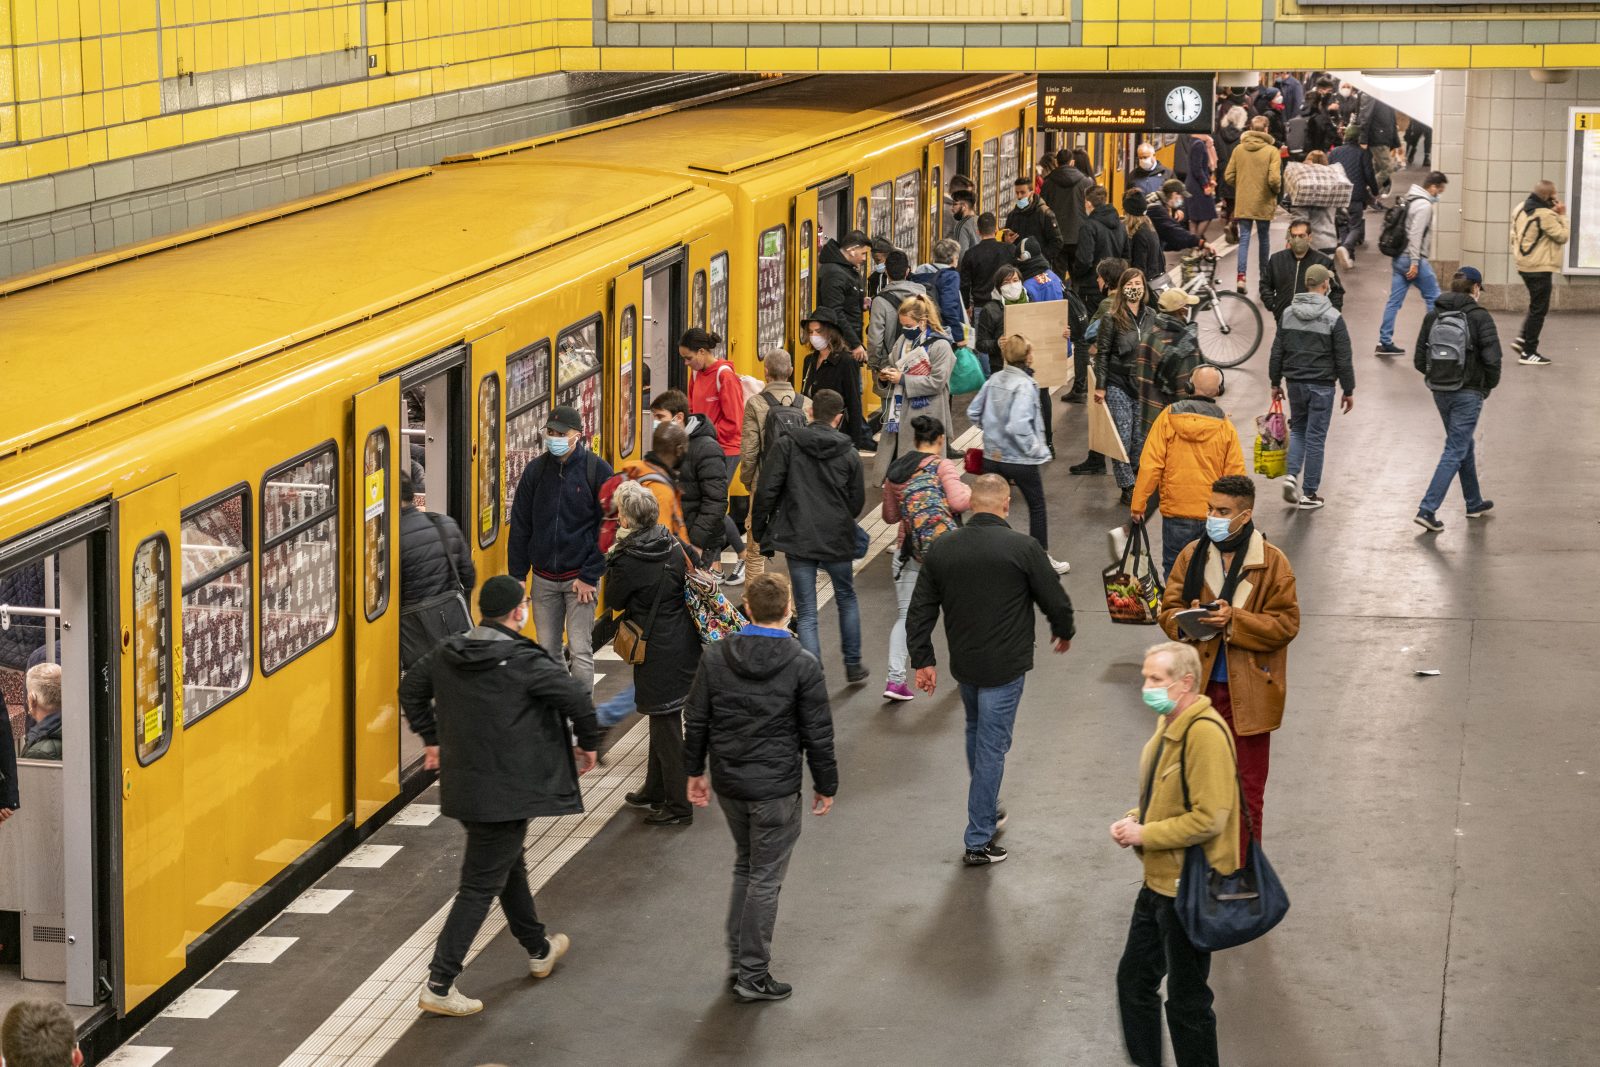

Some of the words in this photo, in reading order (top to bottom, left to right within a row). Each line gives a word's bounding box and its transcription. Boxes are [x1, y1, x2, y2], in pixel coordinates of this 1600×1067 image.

[1045, 95, 1056, 106] U7
[1045, 107, 1054, 115] U7
[1060, 107, 1084, 116] Rathaus
[1085, 108, 1111, 117] Spandau
[1047, 115, 1056, 123] Sie
[1057, 115, 1071, 123] bitte
[1072, 115, 1088, 123] Mund
[1089, 115, 1100, 123] und
